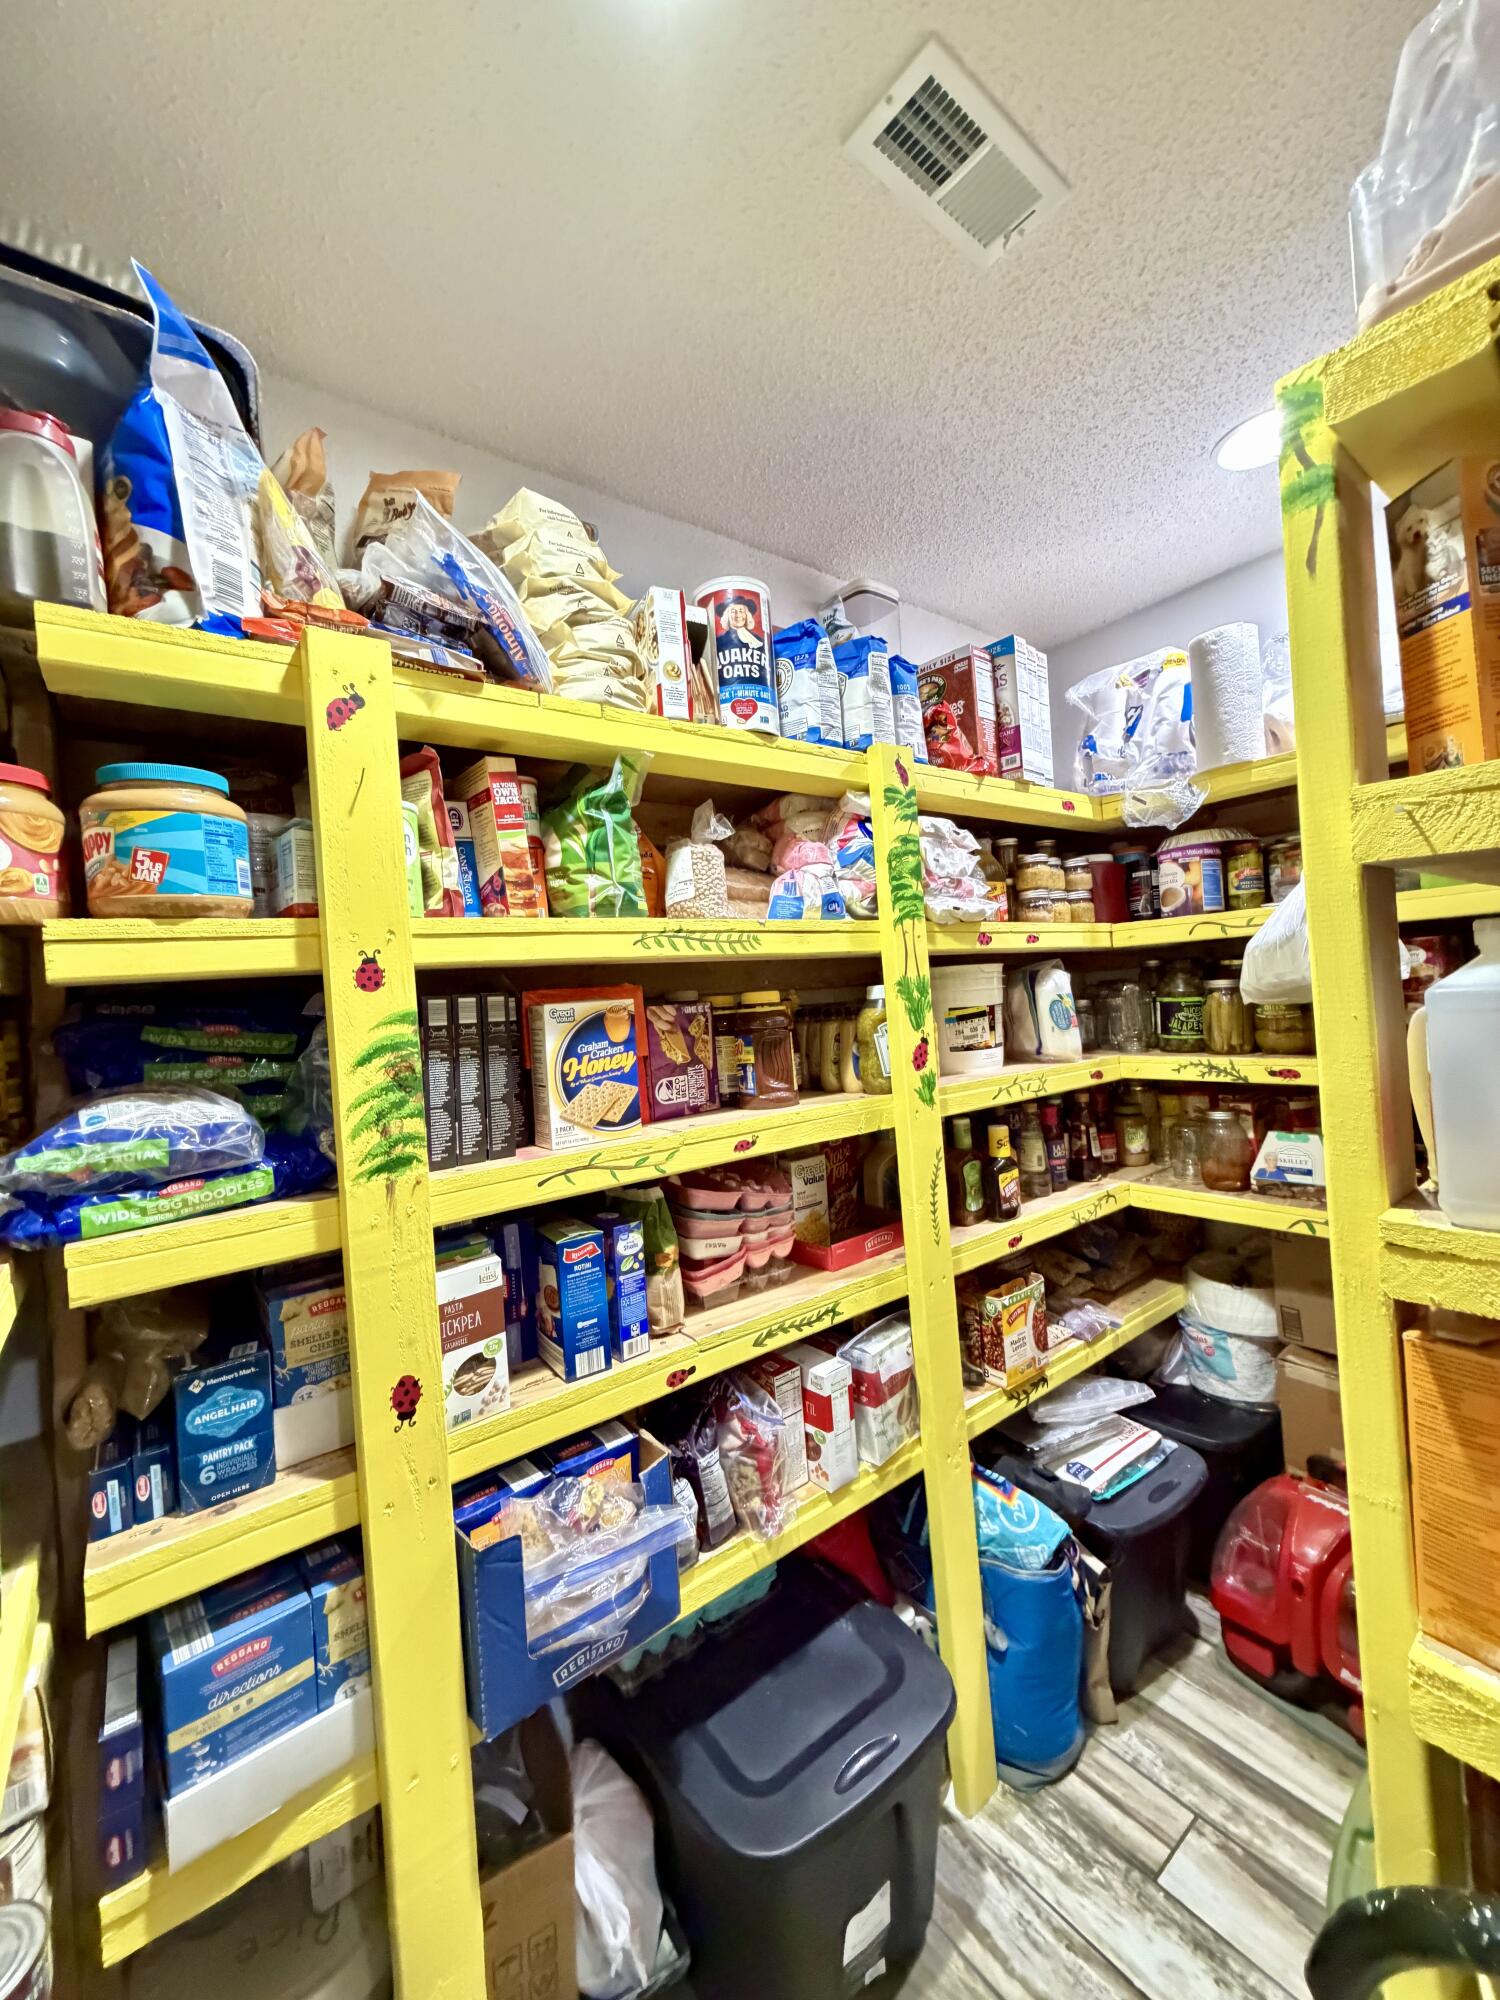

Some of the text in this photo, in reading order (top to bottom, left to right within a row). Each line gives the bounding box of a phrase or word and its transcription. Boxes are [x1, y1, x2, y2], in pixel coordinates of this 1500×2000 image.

[939, 654, 956, 665] SIZE
[723, 664, 760, 679] OATS
[931, 676, 944, 686] PATH
[731, 688, 760, 698] 1-MINUTE
[493, 788, 518, 797] OWN
[494, 796, 520, 805] JACK
[135, 851, 163, 872] 5 LB
[132, 870, 161, 883] JAR
[458, 847, 473, 906] CANE SUGAR
[550, 1008, 574, 1018] Great
[150, 1034, 185, 1046] WIDE
[577, 1041, 609, 1054] Graham
[591, 1044, 624, 1059] Crackers
[563, 1050, 636, 1081] Honey
[152, 1070, 190, 1080] WIDE
[688, 1066, 698, 1106] 12 CRUNCHY
[697, 1064, 706, 1106] TACO SHELLS
[795, 1160, 825, 1177] Great
[1279, 1158, 1309, 1166] SKILLET
[803, 1174, 825, 1186] Value
[833, 1162, 848, 1184] Top
[91, 1178, 265, 1225] WIDE EGG NOODLES
[574, 1262, 592, 1271] ROTINI
[444, 1302, 463, 1315] PASTA
[290, 1330, 330, 1348] SHELLS
[1010, 1336, 1027, 1346] Madras
[1012, 1342, 1027, 1352] Lentils
[206, 1368, 256, 1385] Member's Mark
[984, 1369, 989, 1378] 8
[194, 1399, 258, 1425] ANGEL HAIR
[202, 1440, 254, 1464] PANTRY PACK
[199, 1451, 258, 1485] 6 INDIVIDUALLY
[217, 1459, 258, 1475] WRAPPED
[212, 1483, 250, 1501] OPEN HERE
[216, 1639, 269, 1671] REGGANO
[208, 1663, 282, 1711] directions
